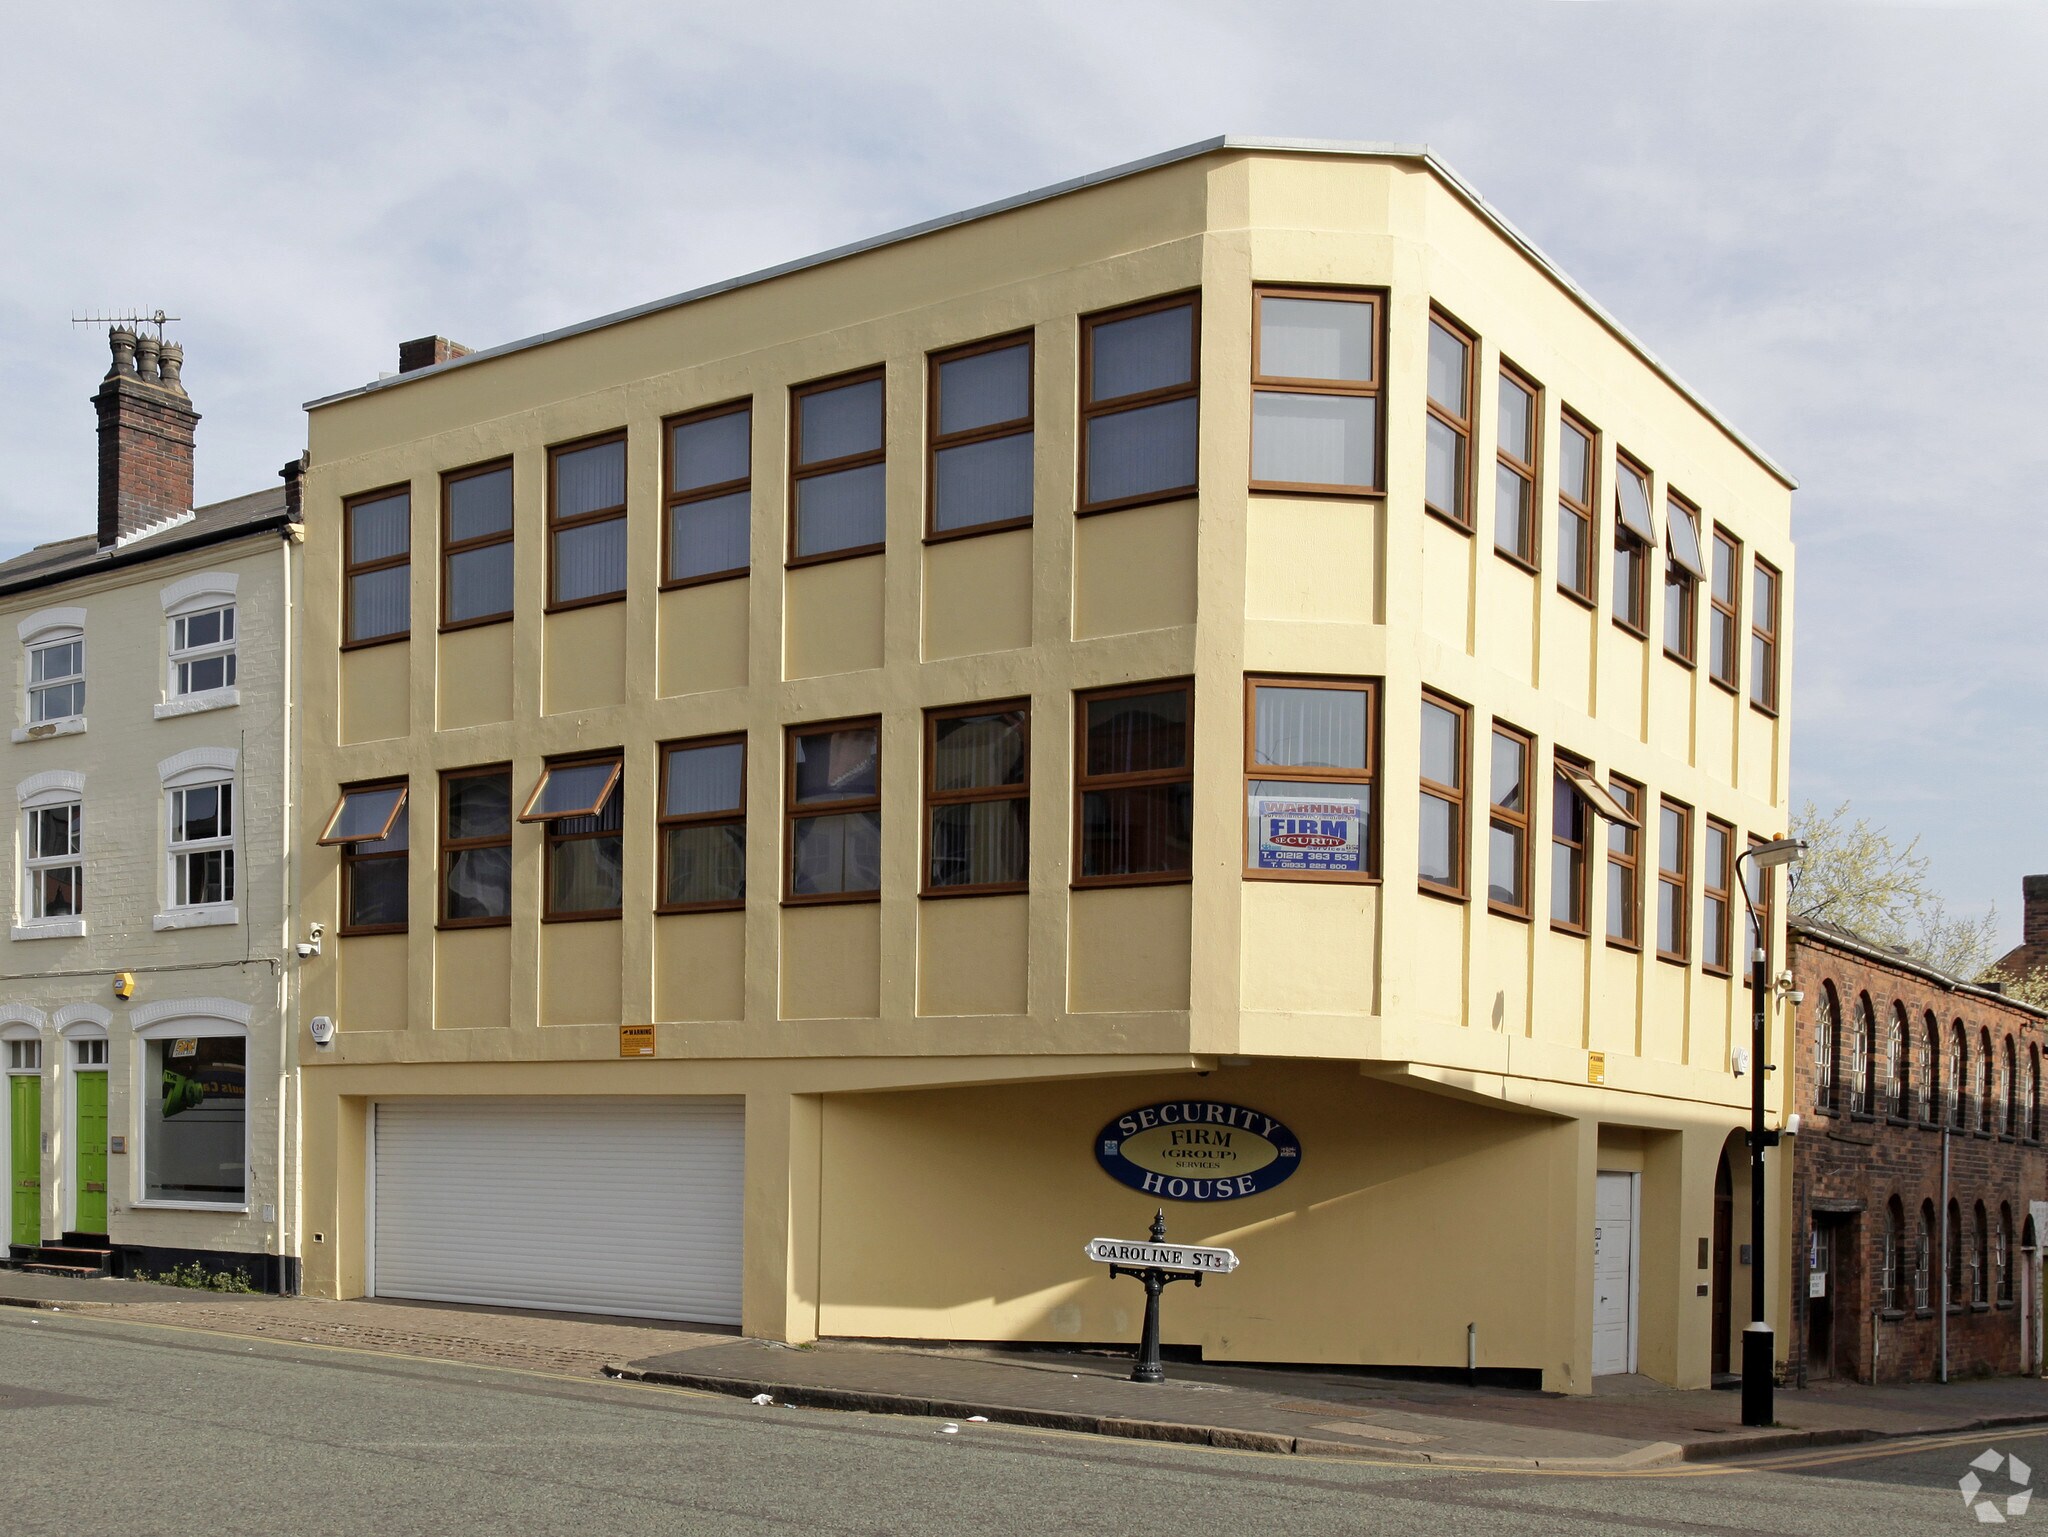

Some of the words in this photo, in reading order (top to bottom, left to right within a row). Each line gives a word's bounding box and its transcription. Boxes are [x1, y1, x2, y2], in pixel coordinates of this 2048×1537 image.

[1264, 802, 1356, 815] WARNING
[1270, 819, 1347, 840] FIRM
[1275, 837, 1340, 846] SECURITY
[1261, 851, 1271, 859] T.
[1275, 852, 1304, 860] 01212
[1118, 1103, 1281, 1138] SECURITY
[1171, 1129, 1232, 1147] FIRM
[1162, 1149, 1237, 1161] (GROUP)
[1175, 1161, 1221, 1169] SERVICES
[1141, 1172, 1256, 1199] HOUSE
[1098, 1245, 1183, 1264] CAROLINE
[1192, 1253, 1214, 1267] ST
